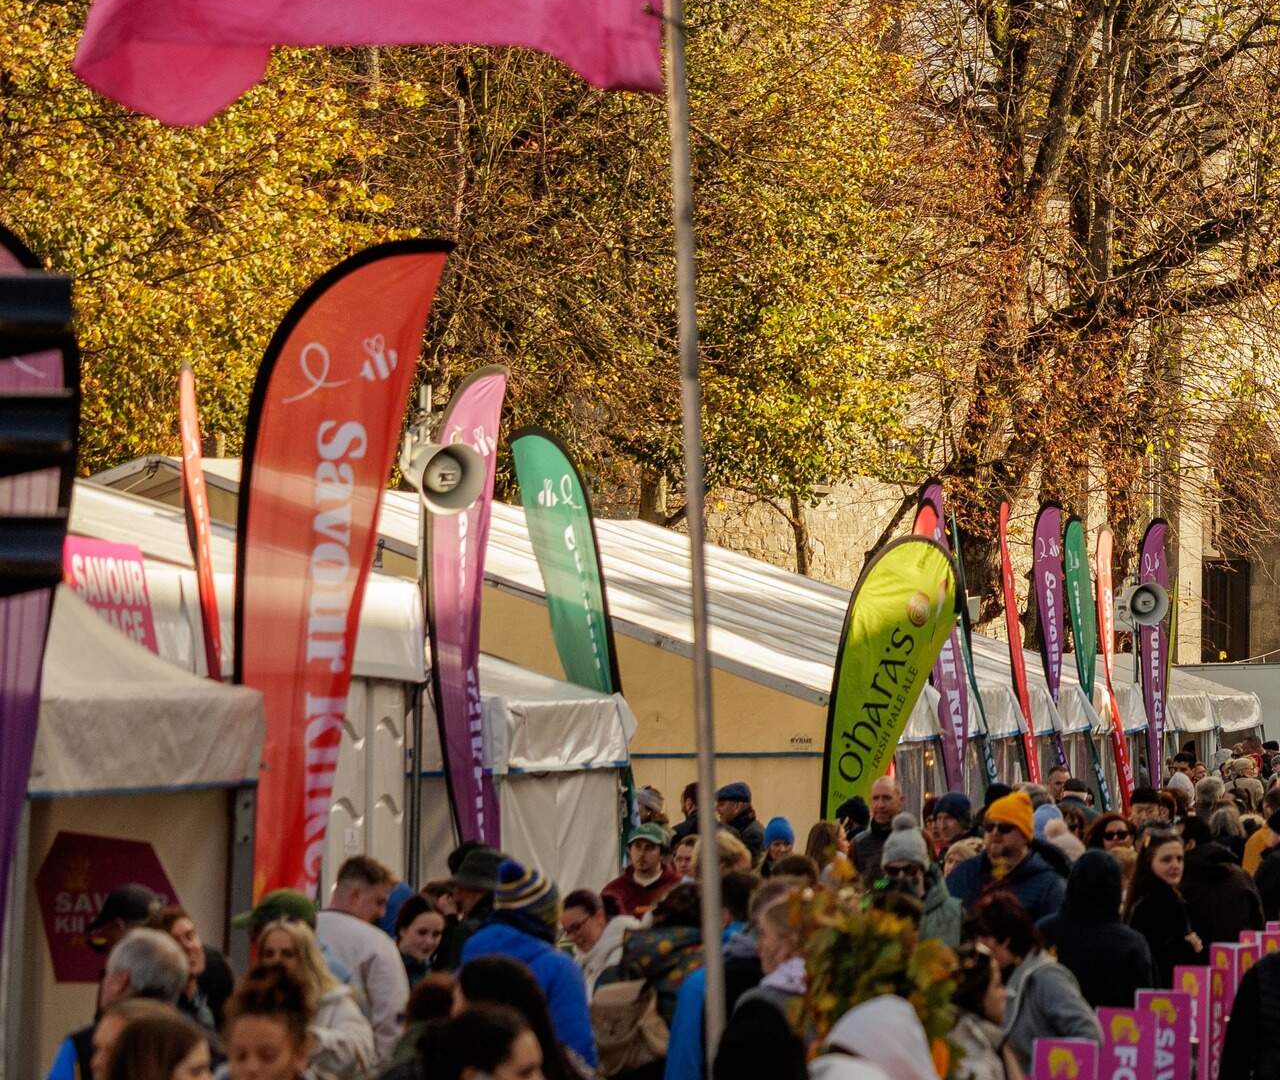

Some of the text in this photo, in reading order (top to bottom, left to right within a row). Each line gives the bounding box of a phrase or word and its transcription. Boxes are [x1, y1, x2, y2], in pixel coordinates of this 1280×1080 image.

[71, 553, 148, 606] SAVOUR
[307, 419, 367, 675] Savour
[871, 666, 918, 769] IRISH PALE ALE
